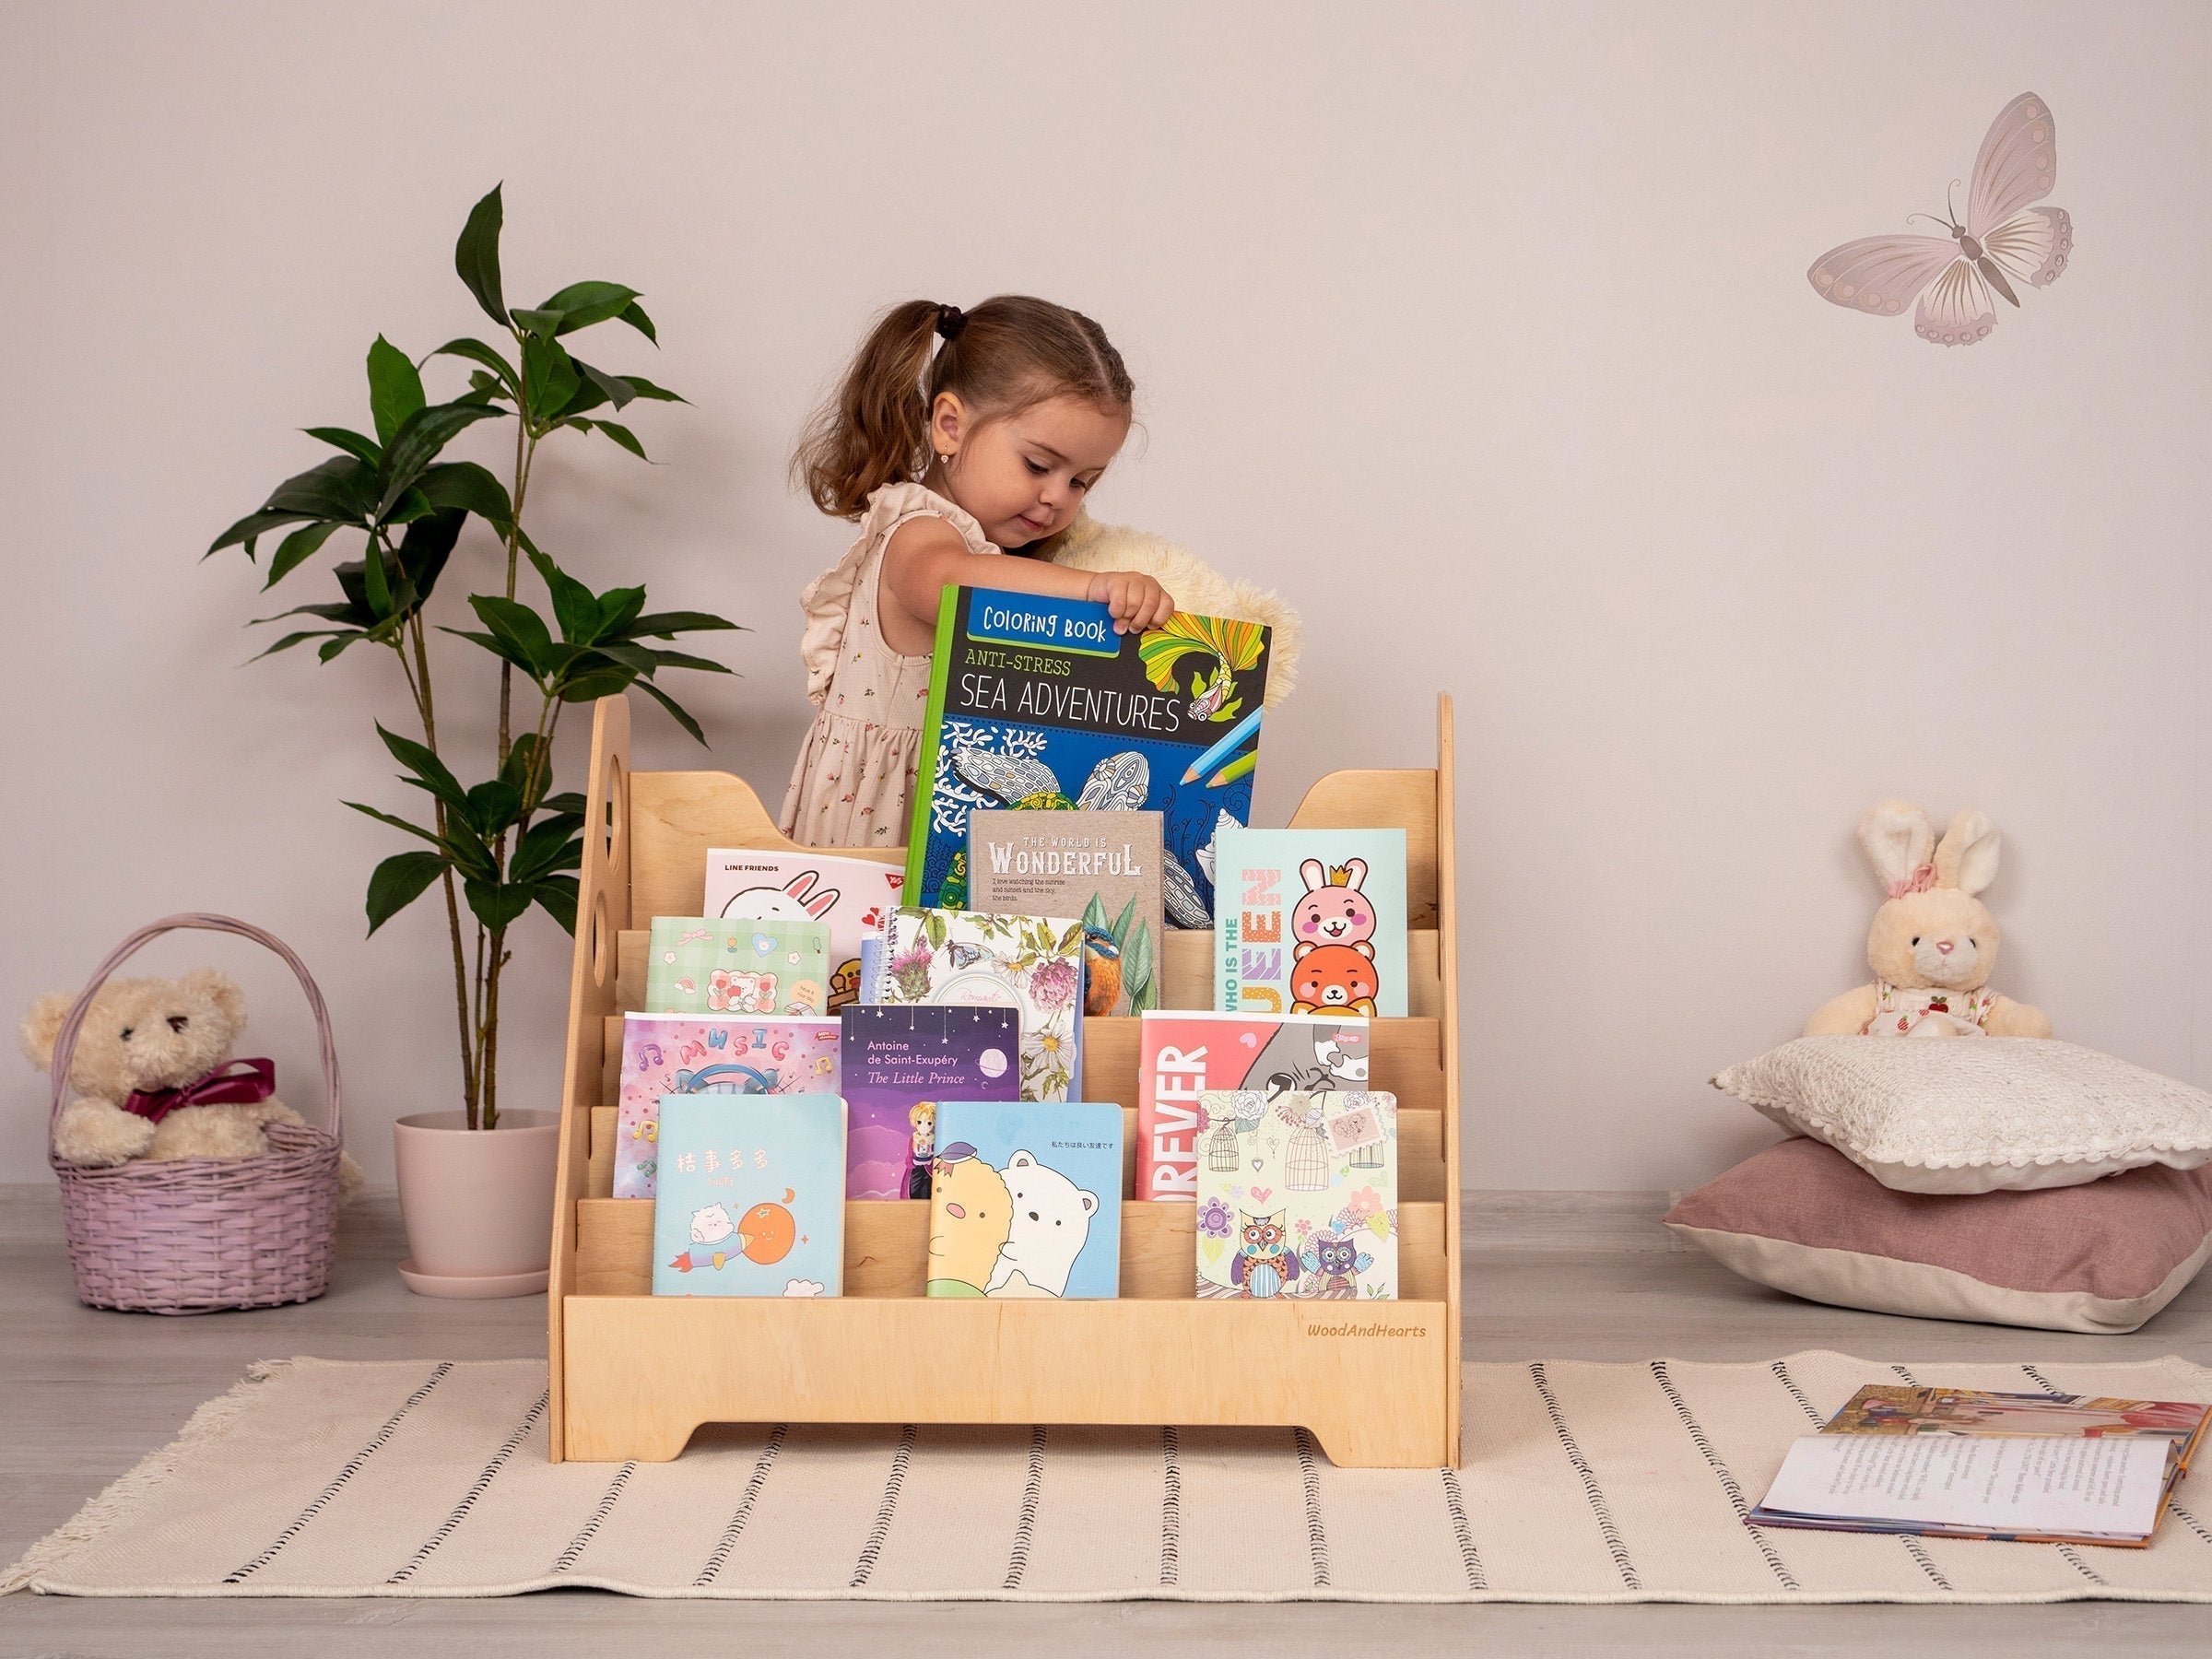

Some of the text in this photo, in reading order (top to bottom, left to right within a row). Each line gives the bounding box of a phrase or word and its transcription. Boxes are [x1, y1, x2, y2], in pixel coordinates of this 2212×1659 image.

[964, 648, 1072, 677] ANTI-STRESS
[959, 673, 1181, 733] SEA ADVENTURES
[1023, 836, 1108, 848] THE WORLD IS
[988, 841, 1142, 877] WONDERFUL
[1009, 877, 1034, 886] watching
[1225, 918, 1238, 951] THE
[1241, 869, 1282, 1013] UEEN
[1225, 957, 1238, 972] IS
[680, 1028, 790, 1065] MUSIC
[866, 1041, 910, 1052] Antoine
[867, 1054, 959, 1067] de Saint-Exupéry
[867, 1072, 965, 1085] The Little Prince
[1152, 1045, 1209, 1201] REVER
[1307, 1322, 1428, 1337] WoodAndHearts
